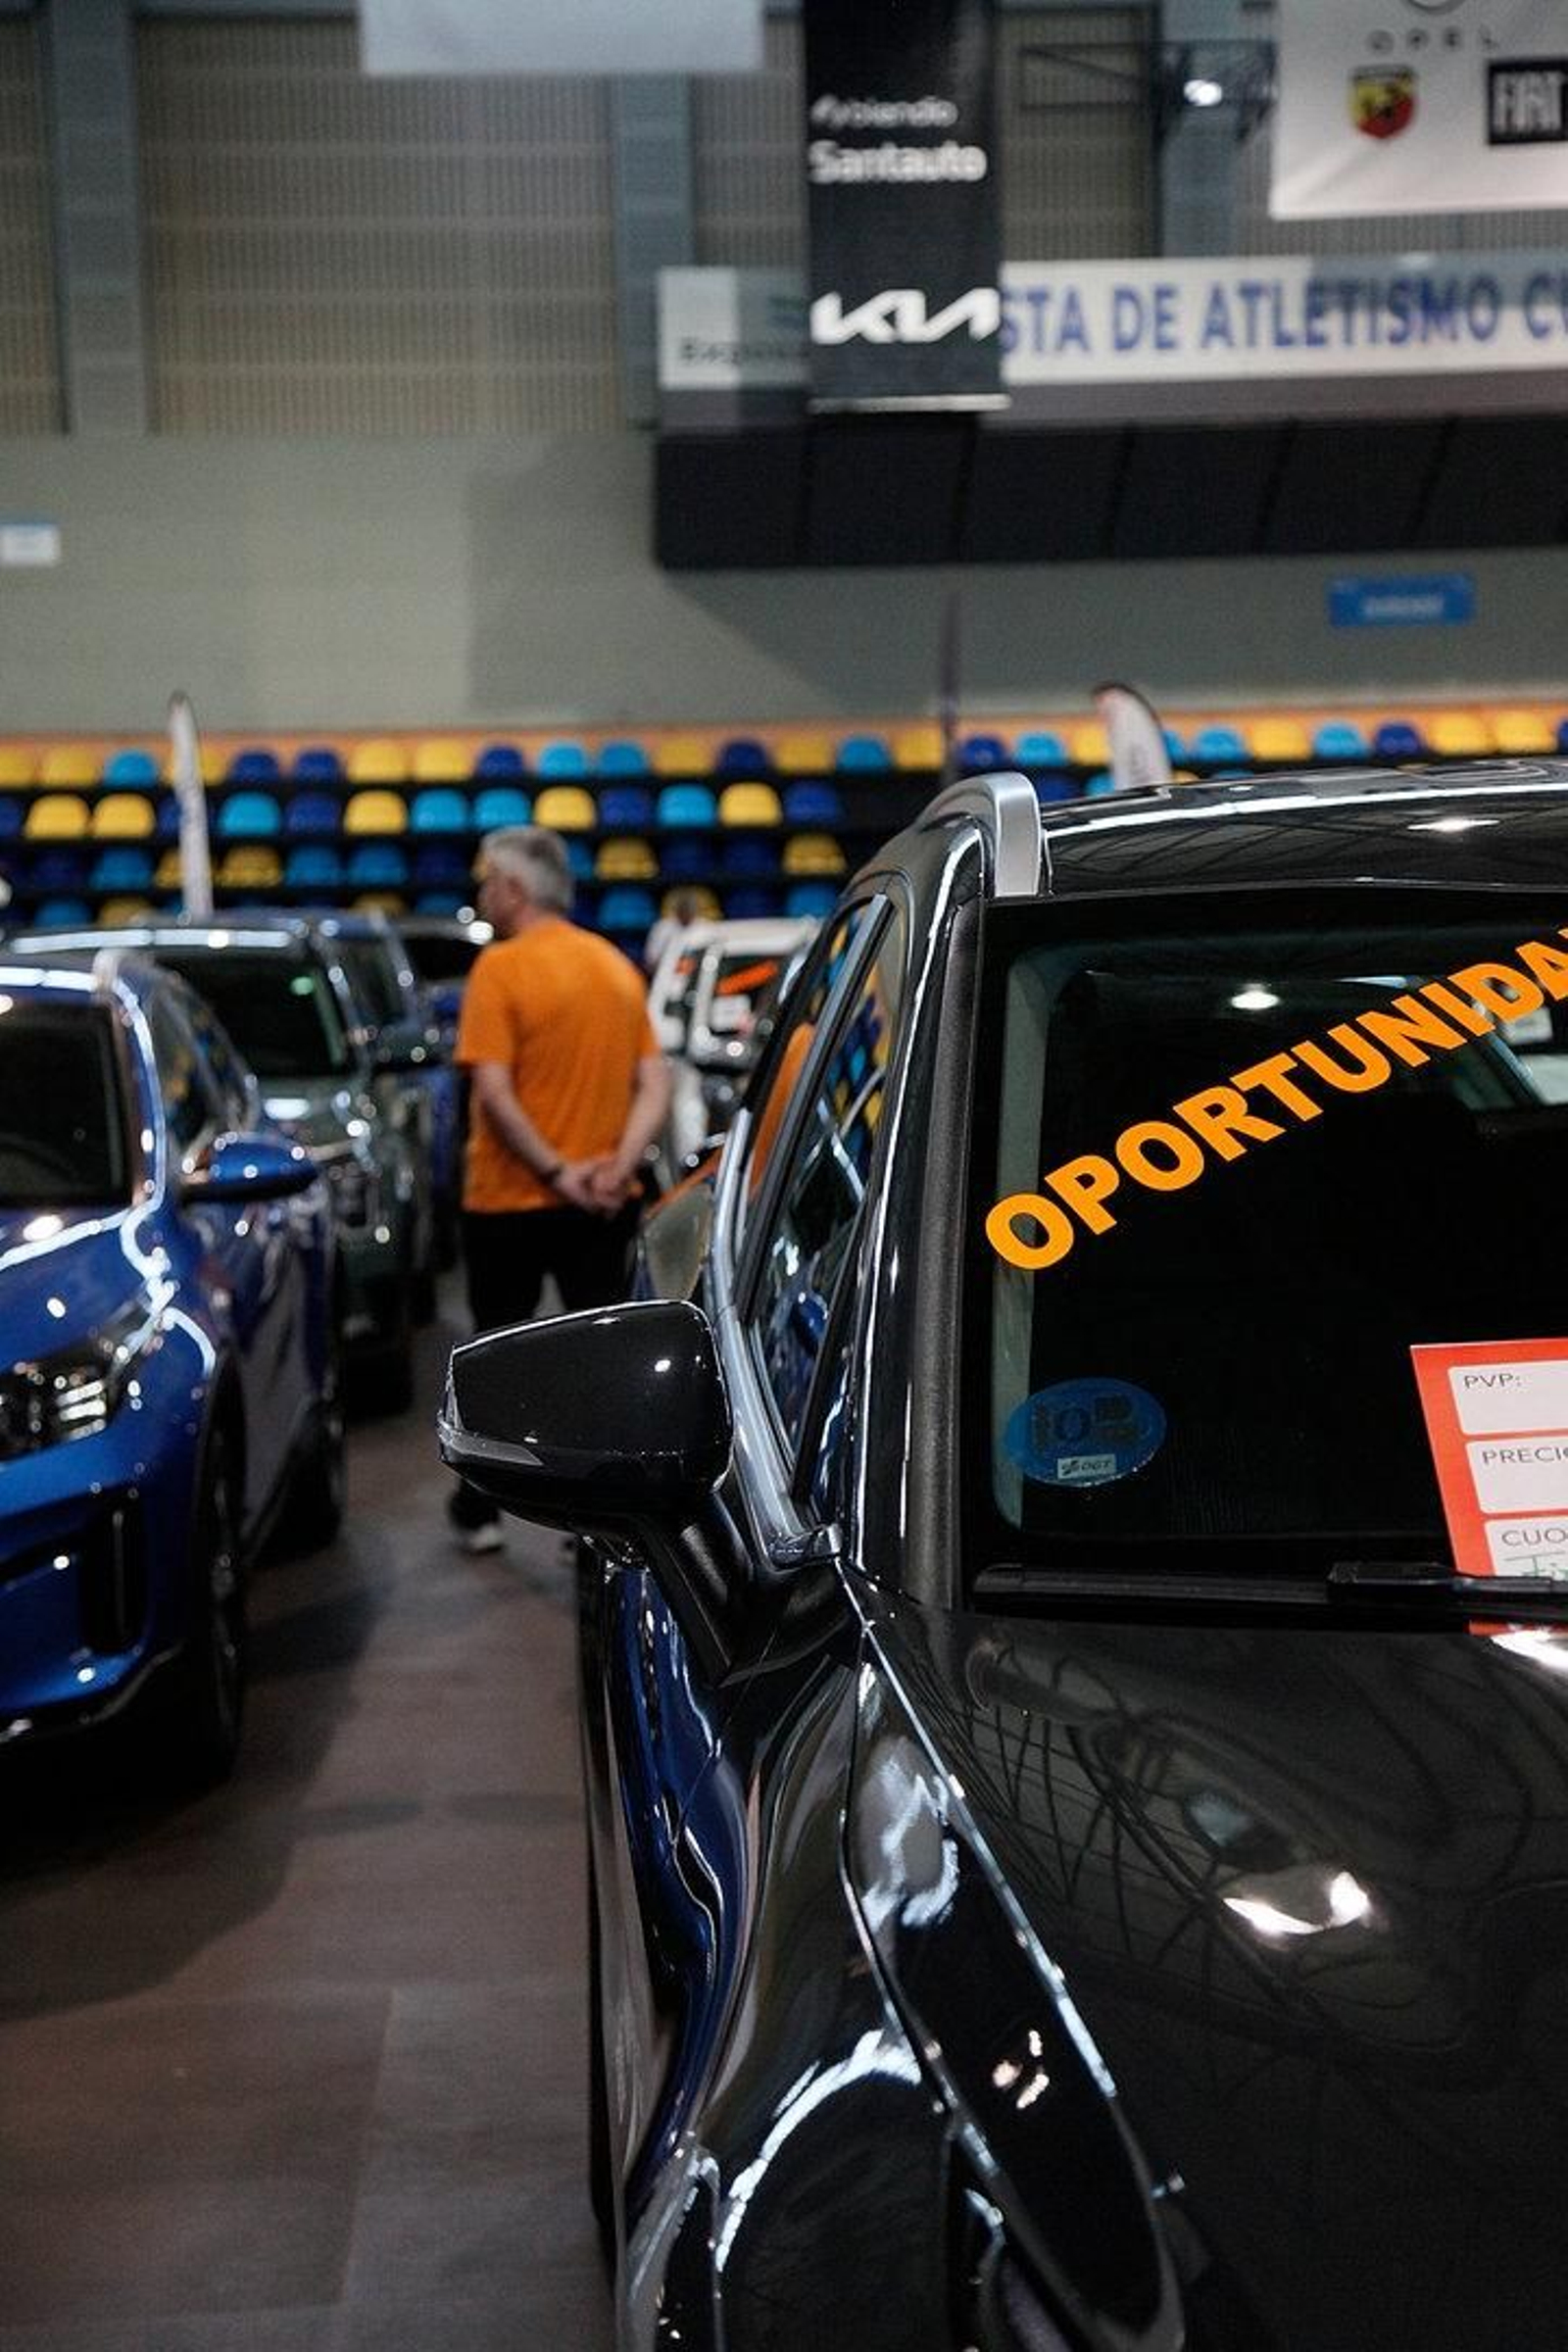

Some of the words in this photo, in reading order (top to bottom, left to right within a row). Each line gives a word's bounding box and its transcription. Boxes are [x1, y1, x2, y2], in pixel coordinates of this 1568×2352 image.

[1112, 283, 1180, 350] DE
[1200, 274, 1499, 347] ATLETISMO
[1524, 271, 1568, 341] C
[986, 928, 1568, 1270] OPORTUNIDA
[1464, 1372, 1522, 1388] PVP:
